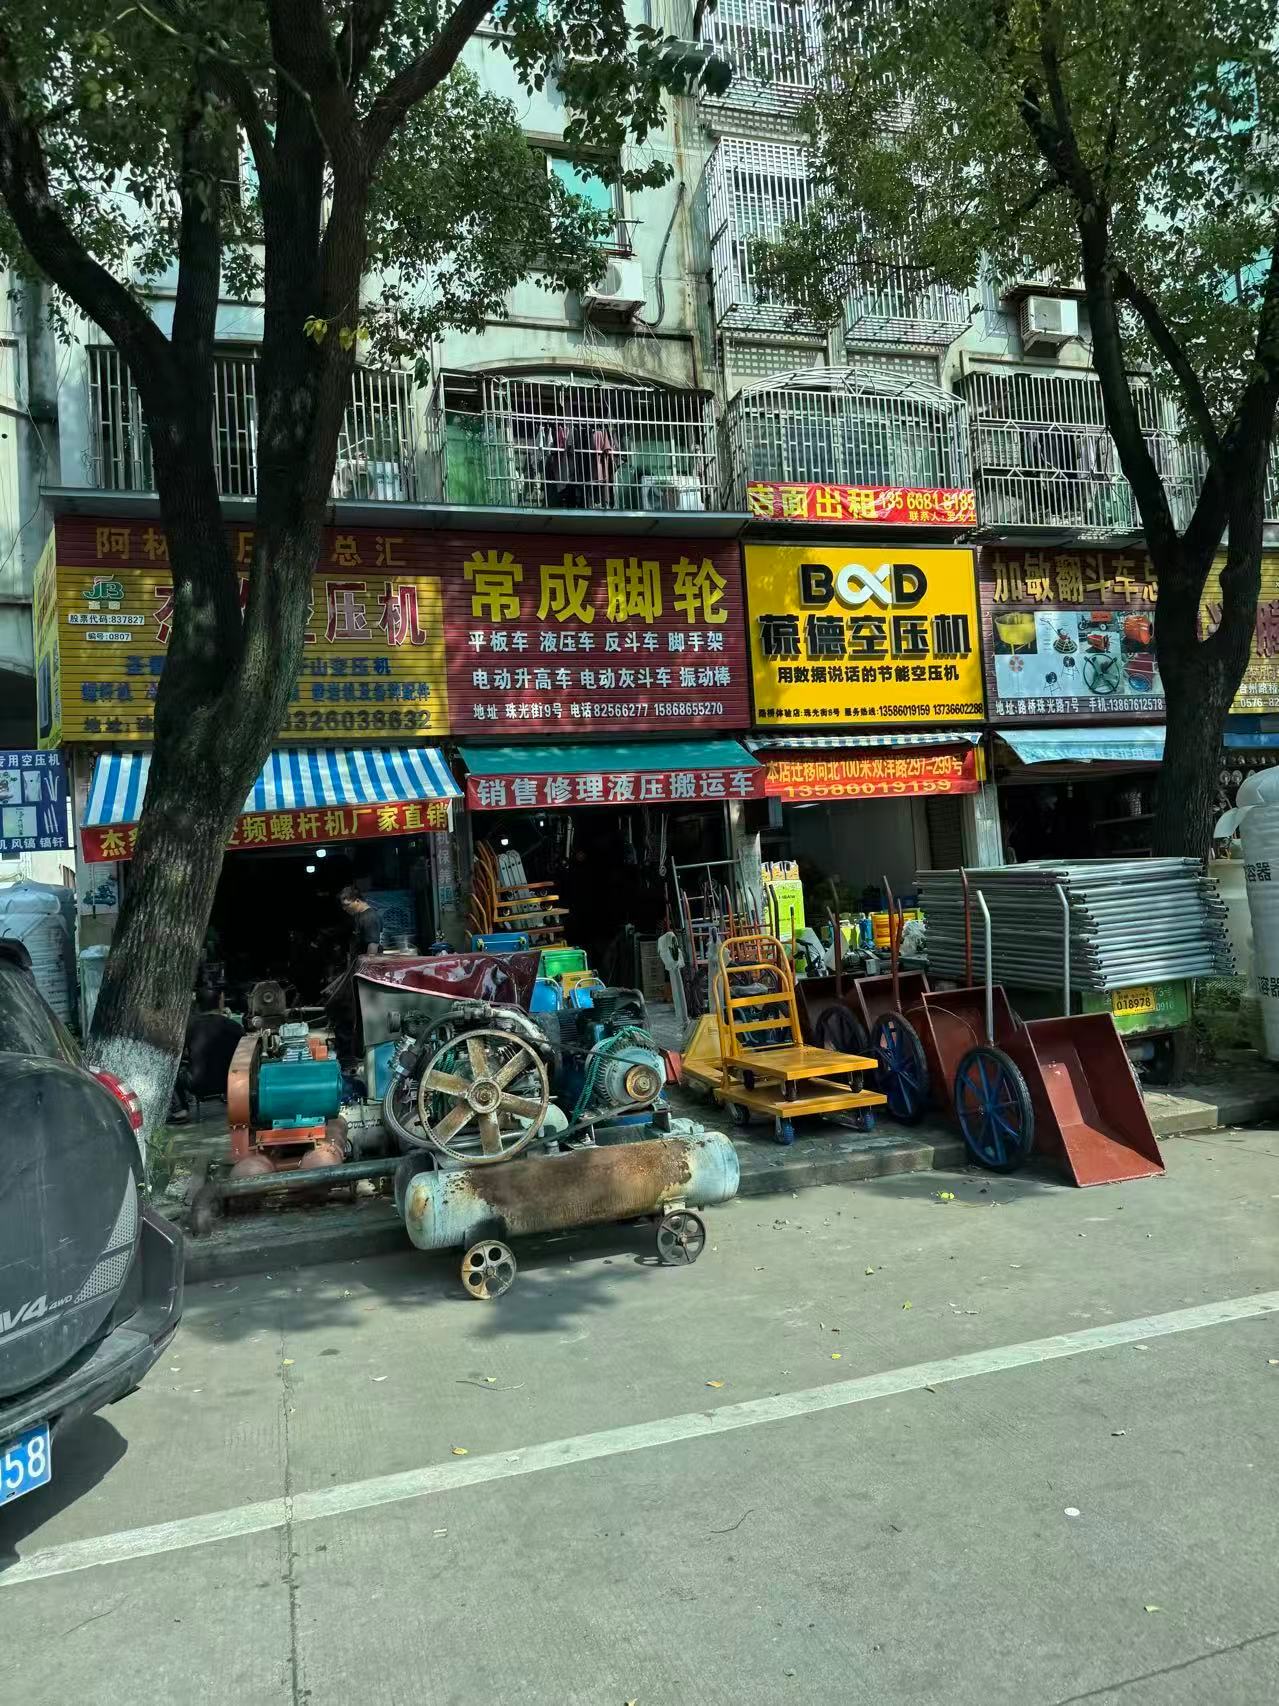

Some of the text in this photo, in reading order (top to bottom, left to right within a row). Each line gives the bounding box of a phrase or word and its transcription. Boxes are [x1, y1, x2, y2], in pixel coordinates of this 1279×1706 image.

[907, 492, 939, 510] 6681
[463, 550, 728, 624] 常成脚轮
[69, 614, 144, 625] 股票代码:837827
[88, 632, 130, 641] 编号:0807
[468, 630, 724, 652] 平板车 液压车 反斗车 脚手架
[757, 614, 972, 655] 葆德空压机
[473, 666, 732, 690] 电动升高车 电动灰斗车 振动棒
[777, 664, 960, 684] 用数据说话的节能空压机
[473, 702, 724, 720] 地址 珠光街9号 电话82566277 15868655270
[933, 702, 984, 715] 13736602288
[995, 698, 1164, 716] 地址:路桥珠光路7号 手机:13867612578
[476, 772, 755, 807] 销售修理液压搬运车
[783, 779, 952, 798] 13586019159
[1116, 996, 1151, 1011] 018978
[0, 1294, 48, 1333] V4
[0, 1436, 46, 1490] 58
